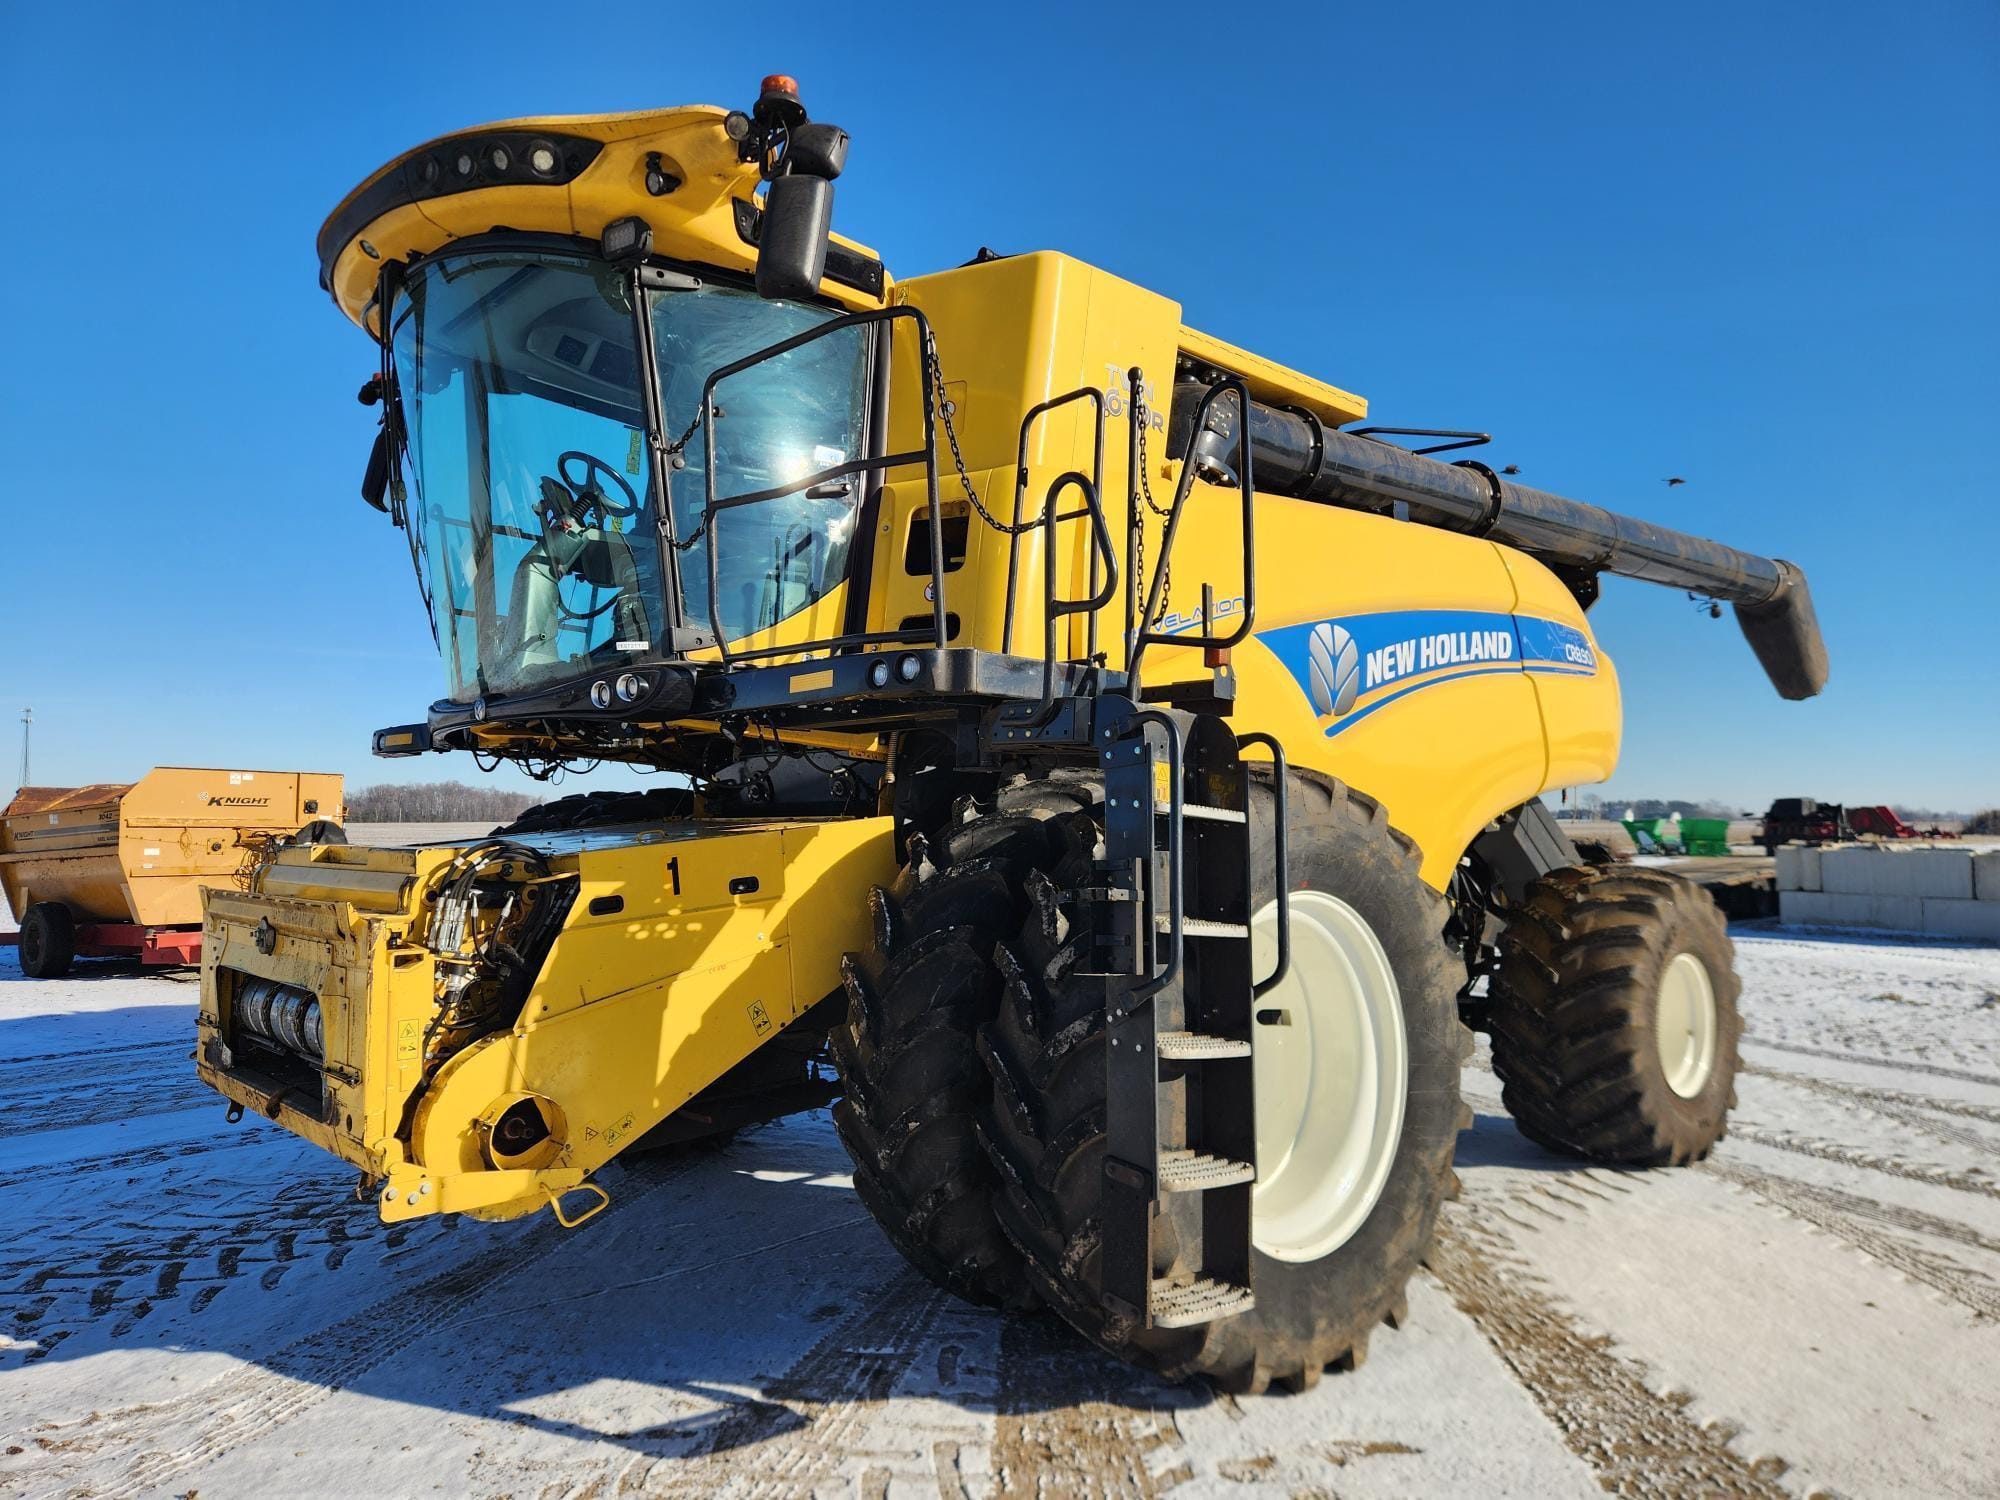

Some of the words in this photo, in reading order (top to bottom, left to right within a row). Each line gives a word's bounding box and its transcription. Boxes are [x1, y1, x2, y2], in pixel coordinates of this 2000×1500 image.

[1366, 639, 1416, 688] NEW
[1420, 631, 1513, 669] HOLLAND
[207, 796, 272, 807] KNIGHT
[667, 856, 681, 896] 1
